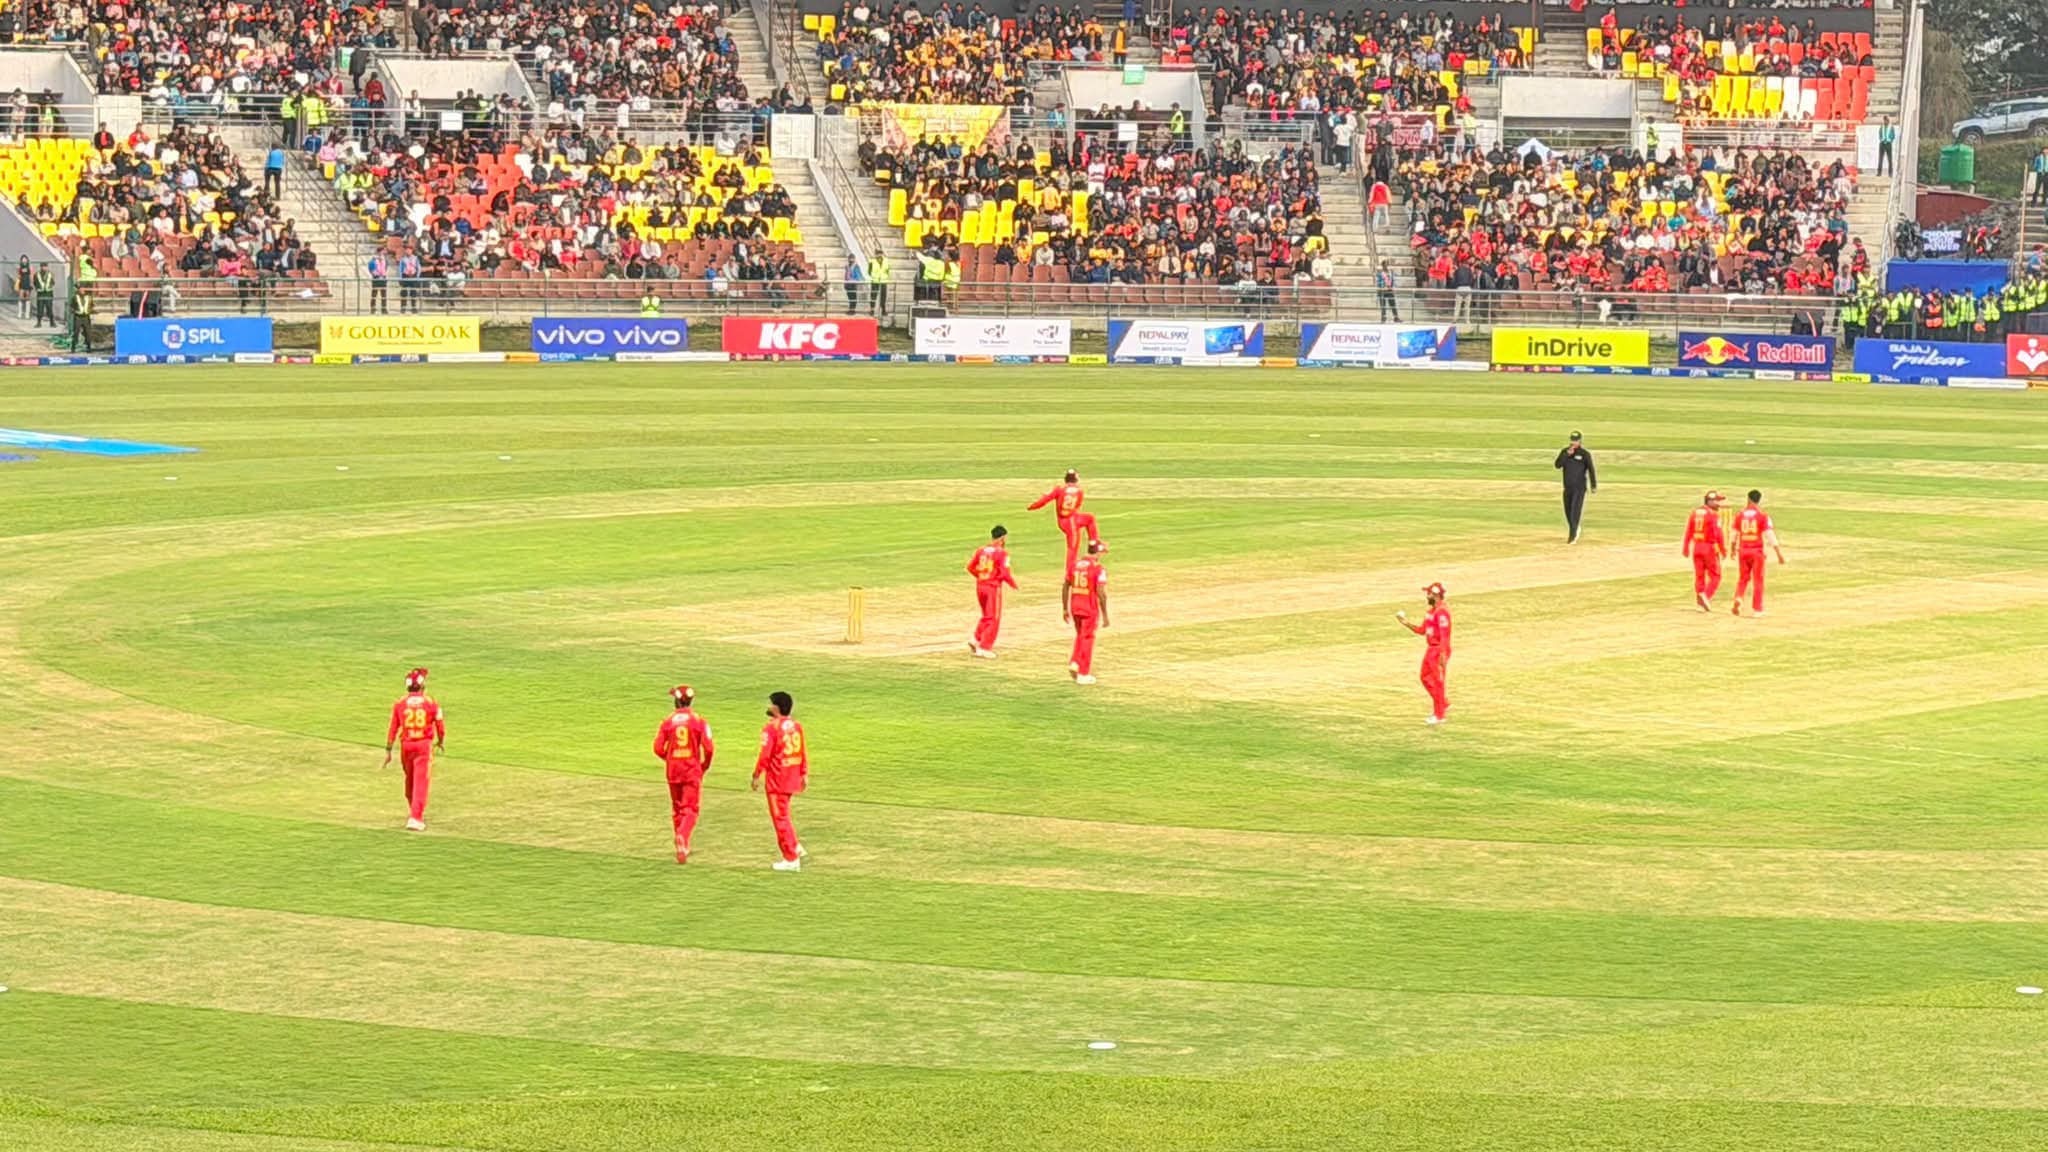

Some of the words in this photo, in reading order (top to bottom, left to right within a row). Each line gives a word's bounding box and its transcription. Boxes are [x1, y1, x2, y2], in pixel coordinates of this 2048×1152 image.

[188, 327, 225, 344] SPIL
[349, 325, 425, 339] GOLDEN
[432, 325, 471, 339] OAK
[537, 324, 606, 345] vivo
[613, 324, 681, 345] vivo
[758, 322, 841, 350] KFC
[1527, 336, 1613, 357] inDrive
[1757, 342, 1791, 363] Red
[1792, 343, 1826, 364] Bull
[1889, 343, 1931, 354] BAJAJ
[1892, 349, 1971, 370] pulsar
[1074, 571, 1089, 587] 16
[404, 708, 427, 728] 28
[675, 725, 689, 747] 9
[783, 731, 802, 755] 39
